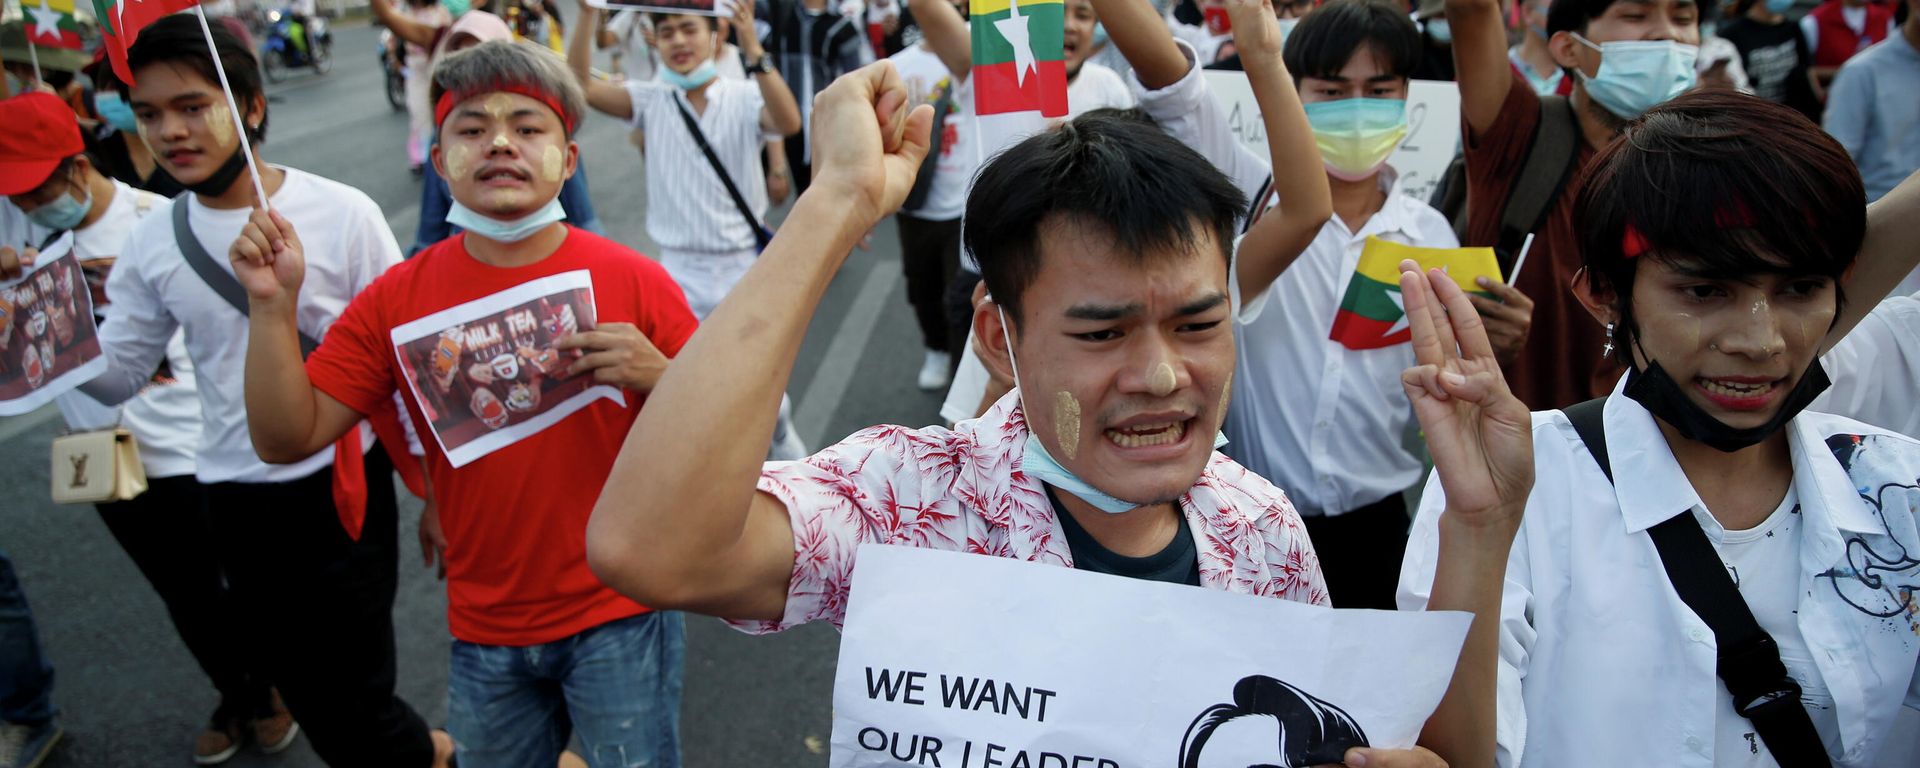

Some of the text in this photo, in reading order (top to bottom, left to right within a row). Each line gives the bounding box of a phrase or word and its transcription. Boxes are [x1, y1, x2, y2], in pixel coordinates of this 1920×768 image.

[465, 322, 503, 351] MILK
[505, 309, 538, 334] TEA
[865, 667, 1056, 722] WE WANT
[858, 727, 943, 768] OUR
